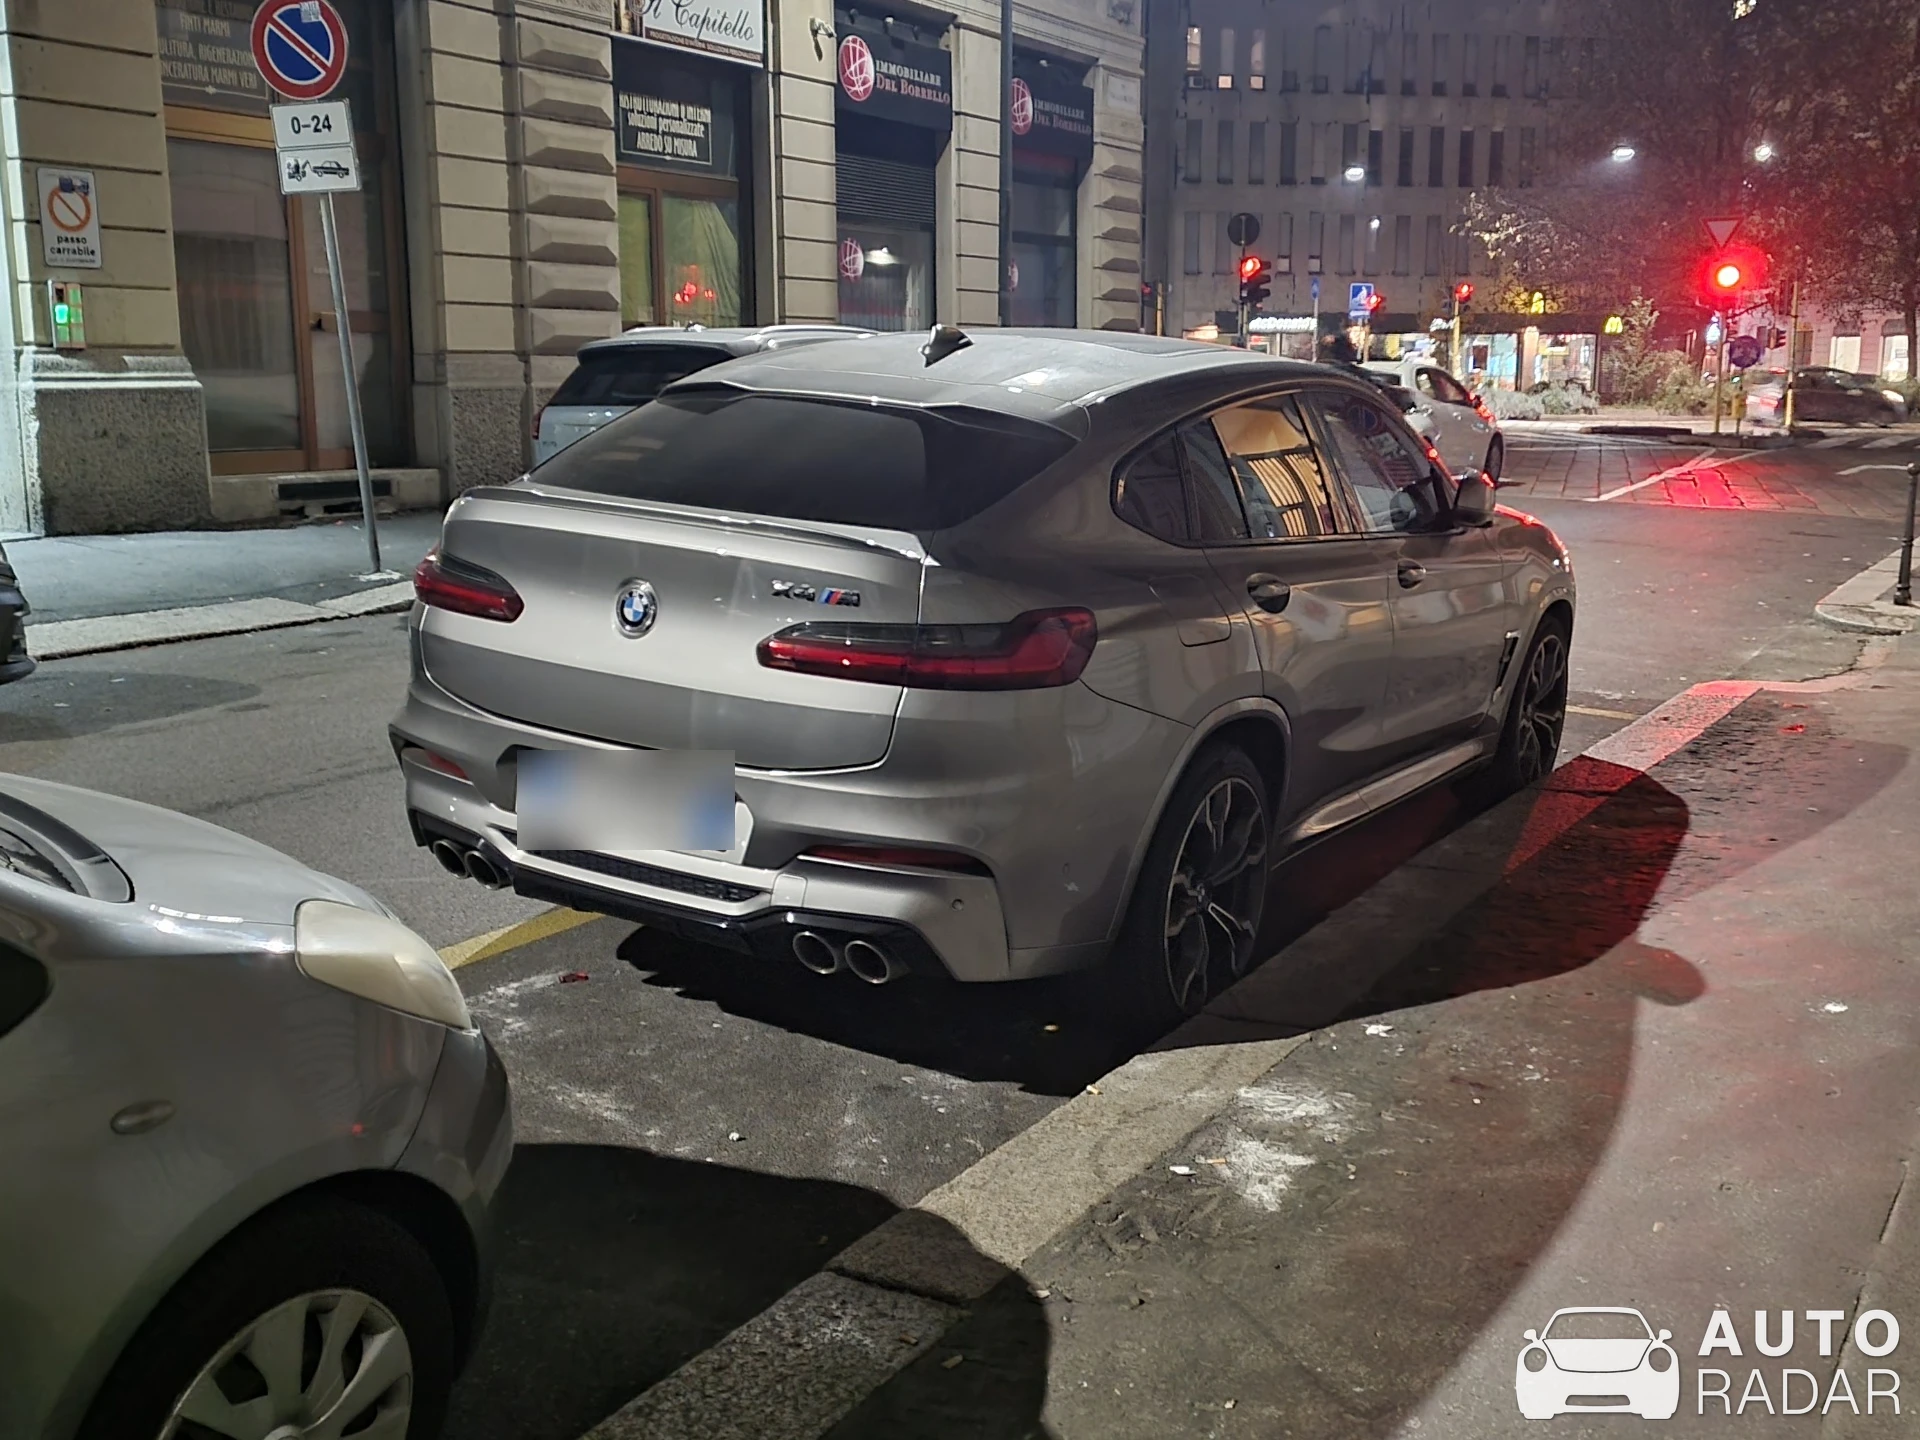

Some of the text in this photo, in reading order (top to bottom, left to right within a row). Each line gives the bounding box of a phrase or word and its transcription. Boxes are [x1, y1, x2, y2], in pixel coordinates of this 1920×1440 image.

[180, 11, 231, 37] FINTI MARMI
[671, 0, 755, 41] Capitello
[158, 38, 256, 67] ULITURA, RIGENERAZION
[161, 61, 258, 89] NCERATURA MARMI VERI
[876, 60, 941, 85] IMMOBILIARE
[1034, 99, 1085, 119] IMMOBILIARE
[291, 114, 332, 134] 0-24
[636, 131, 698, 158] ARREDO SU MISURA
[49, 246, 96, 257] carrabile
[56, 235, 87, 245] passo
